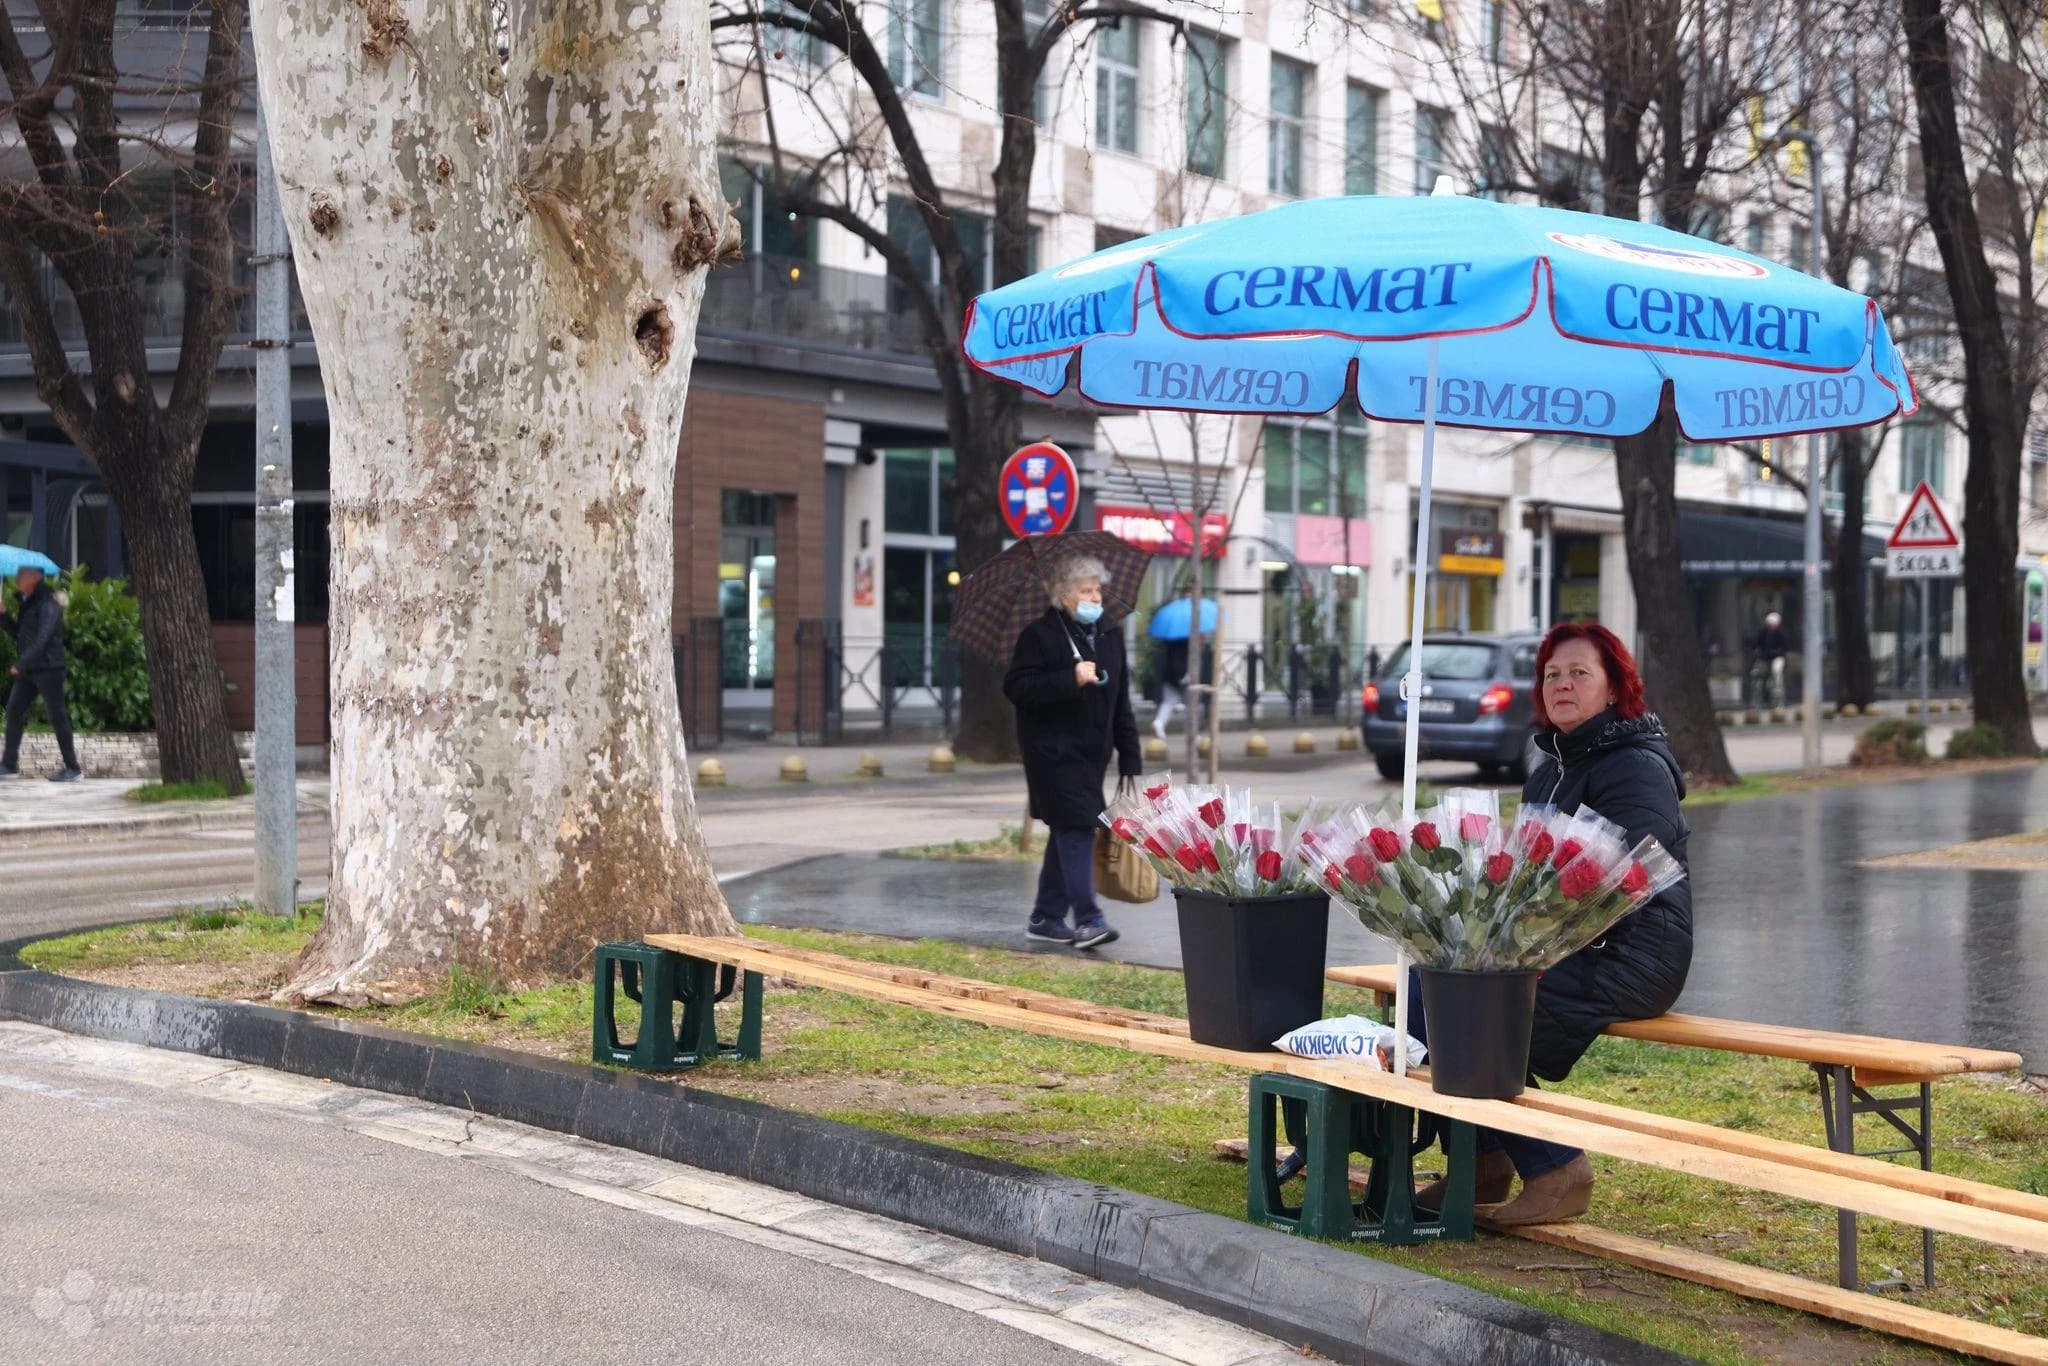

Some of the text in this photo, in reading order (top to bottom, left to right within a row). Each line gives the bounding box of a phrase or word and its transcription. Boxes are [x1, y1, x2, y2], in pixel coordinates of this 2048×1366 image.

[1896, 551, 1950, 572] ŠKOLA
[1351, 1035, 1376, 1056] LC
[1351, 1228, 1385, 1240] Jamnica
[1413, 1226, 1447, 1238] Jamnica
